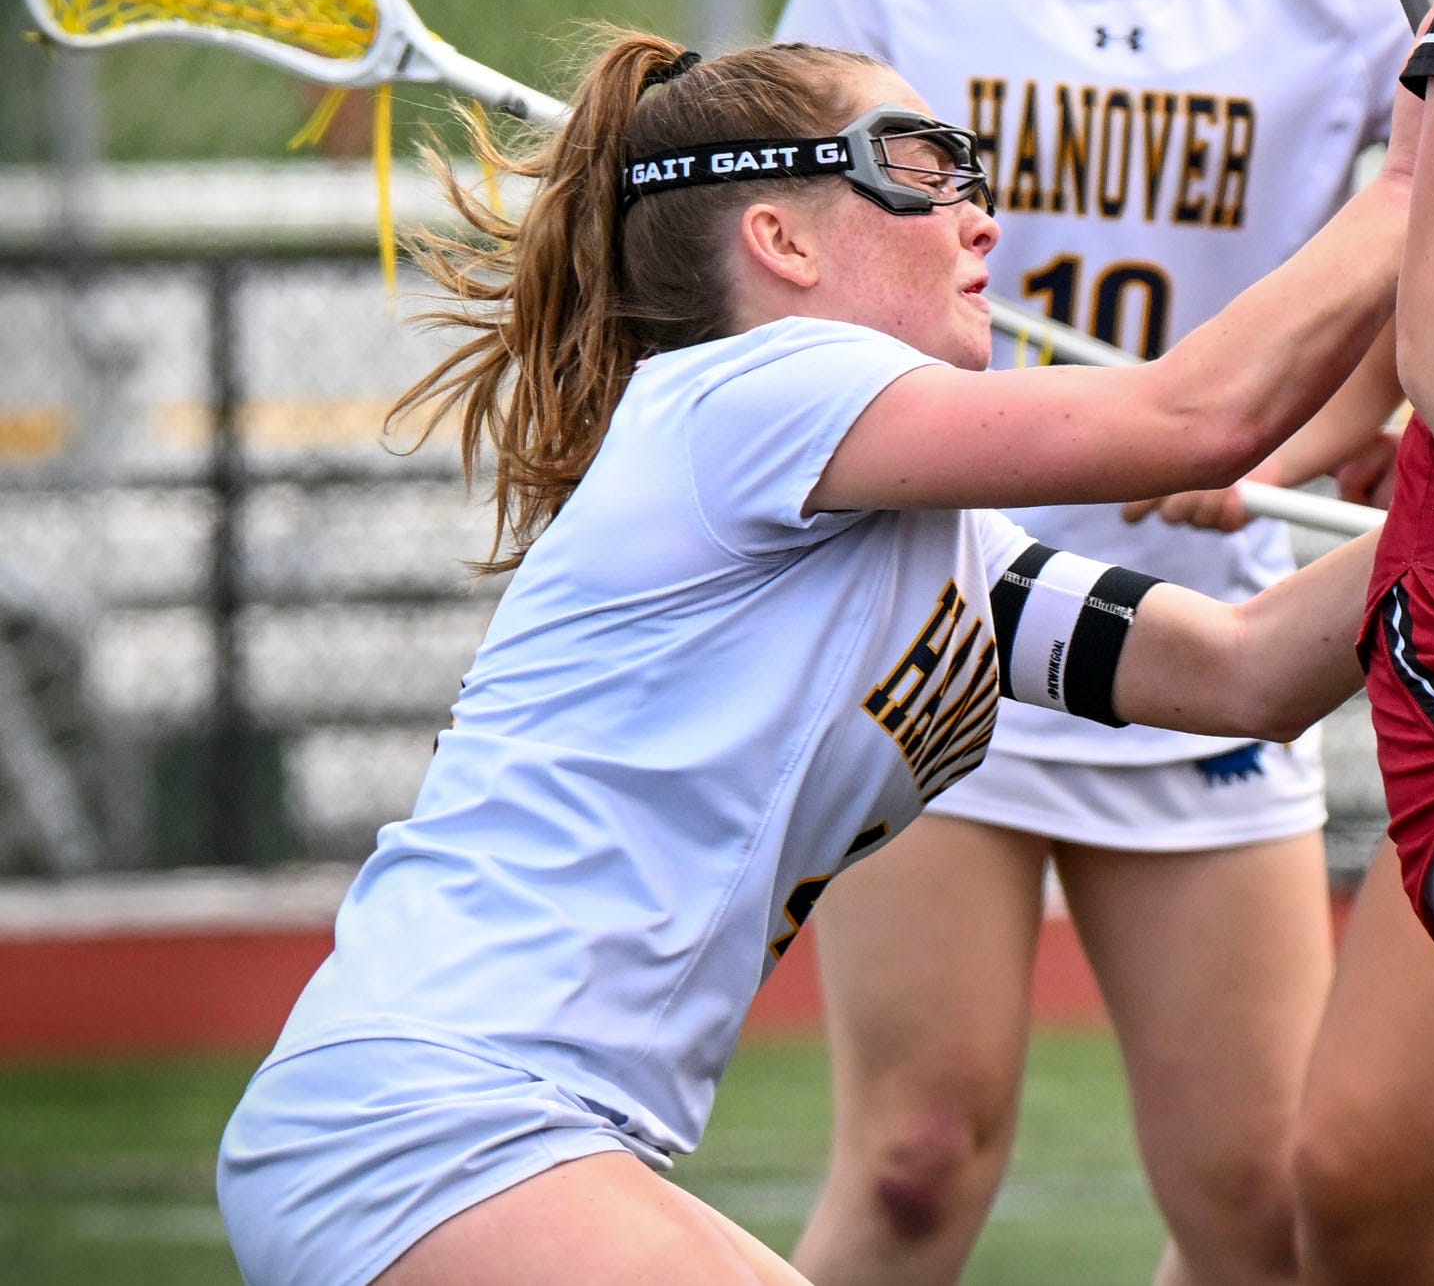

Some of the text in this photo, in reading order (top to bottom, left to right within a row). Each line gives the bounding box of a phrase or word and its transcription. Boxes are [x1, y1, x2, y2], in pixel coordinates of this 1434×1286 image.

[631, 156, 696, 185] GAIT
[711, 146, 799, 174] GAIT
[968, 76, 1258, 232] HANOVER
